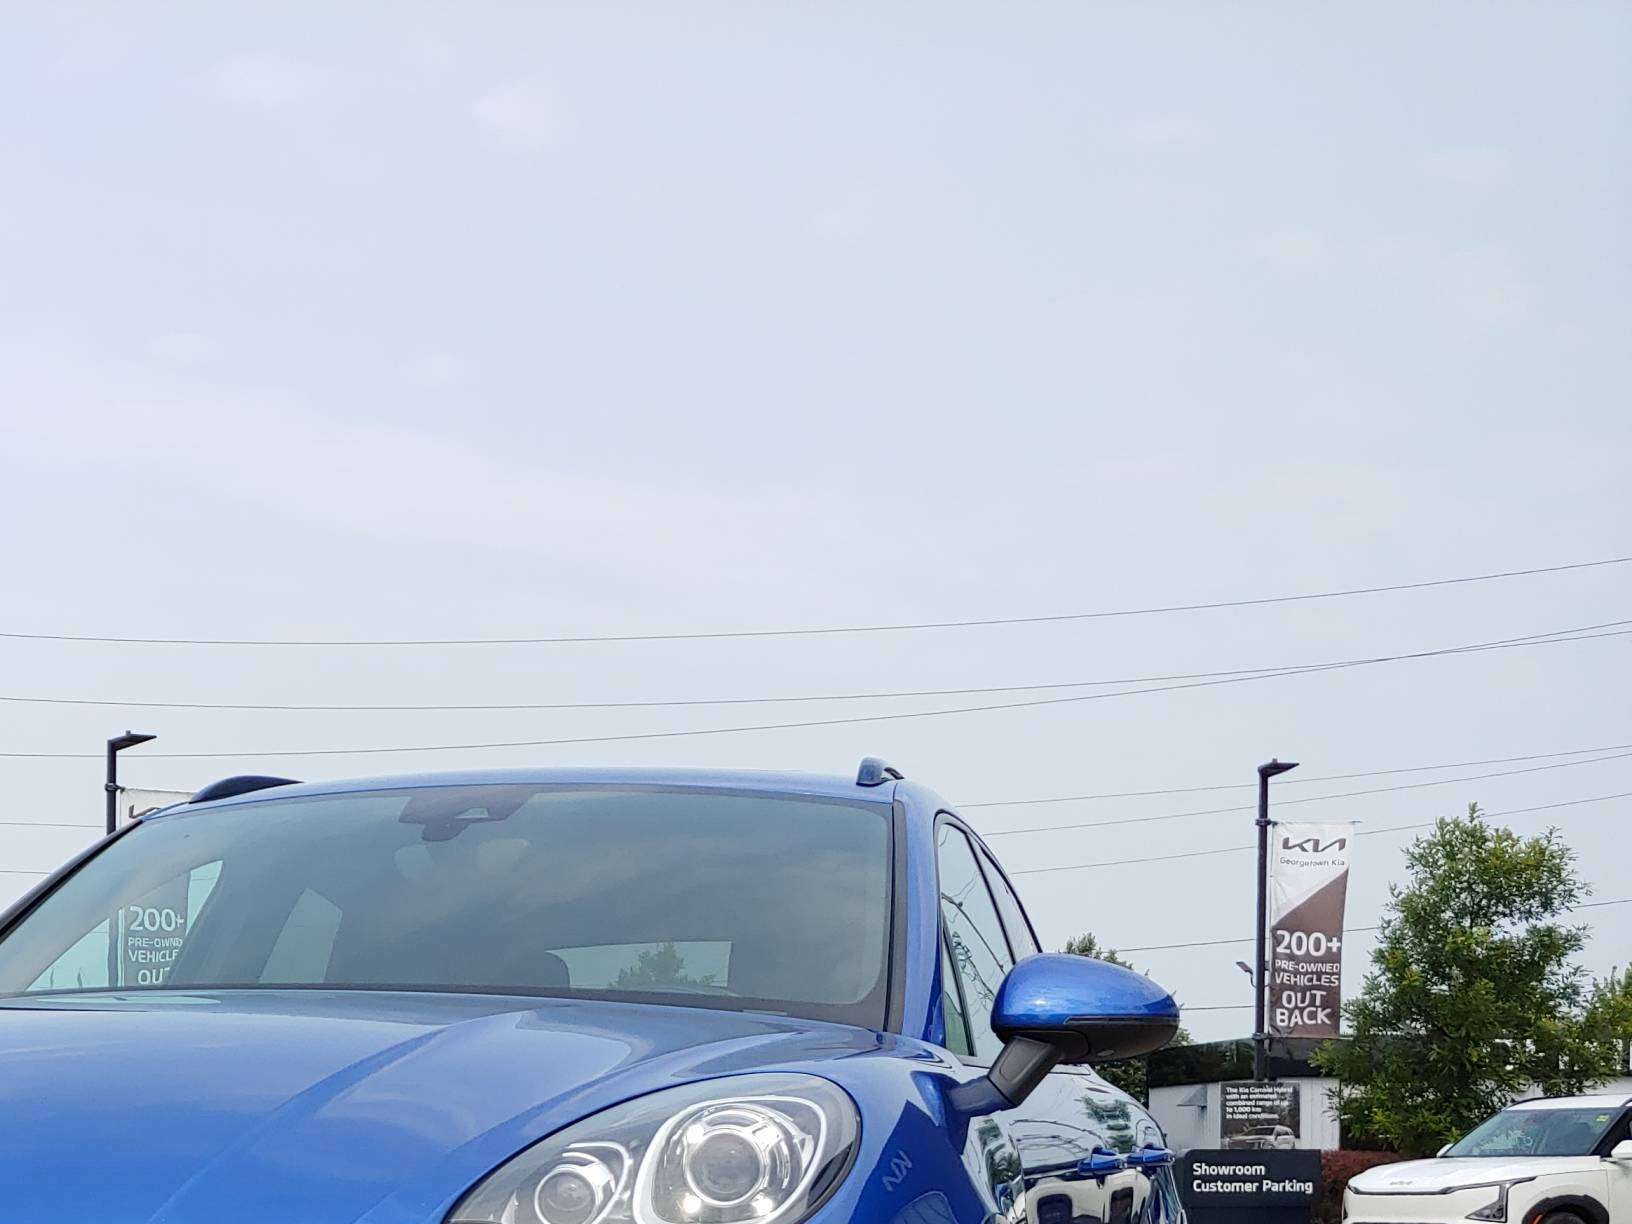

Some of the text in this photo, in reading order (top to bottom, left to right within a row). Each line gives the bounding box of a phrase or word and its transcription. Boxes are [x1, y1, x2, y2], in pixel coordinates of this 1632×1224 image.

[1282, 837, 1346, 852] KIA
[1279, 857, 1329, 867] Georgetown
[129, 906, 185, 931] 200+
[1276, 930, 1341, 956] 200+
[1275, 960, 1340, 973] PRE-OWNED
[137, 967, 170, 985] OU
[1275, 972, 1339, 986] VEHICLES
[1281, 990, 1327, 1008] OUT
[1275, 1006, 1332, 1027] BACK
[1193, 1162, 1265, 1175] Showroom
[1193, 1179, 1313, 1194] Customer Parking
